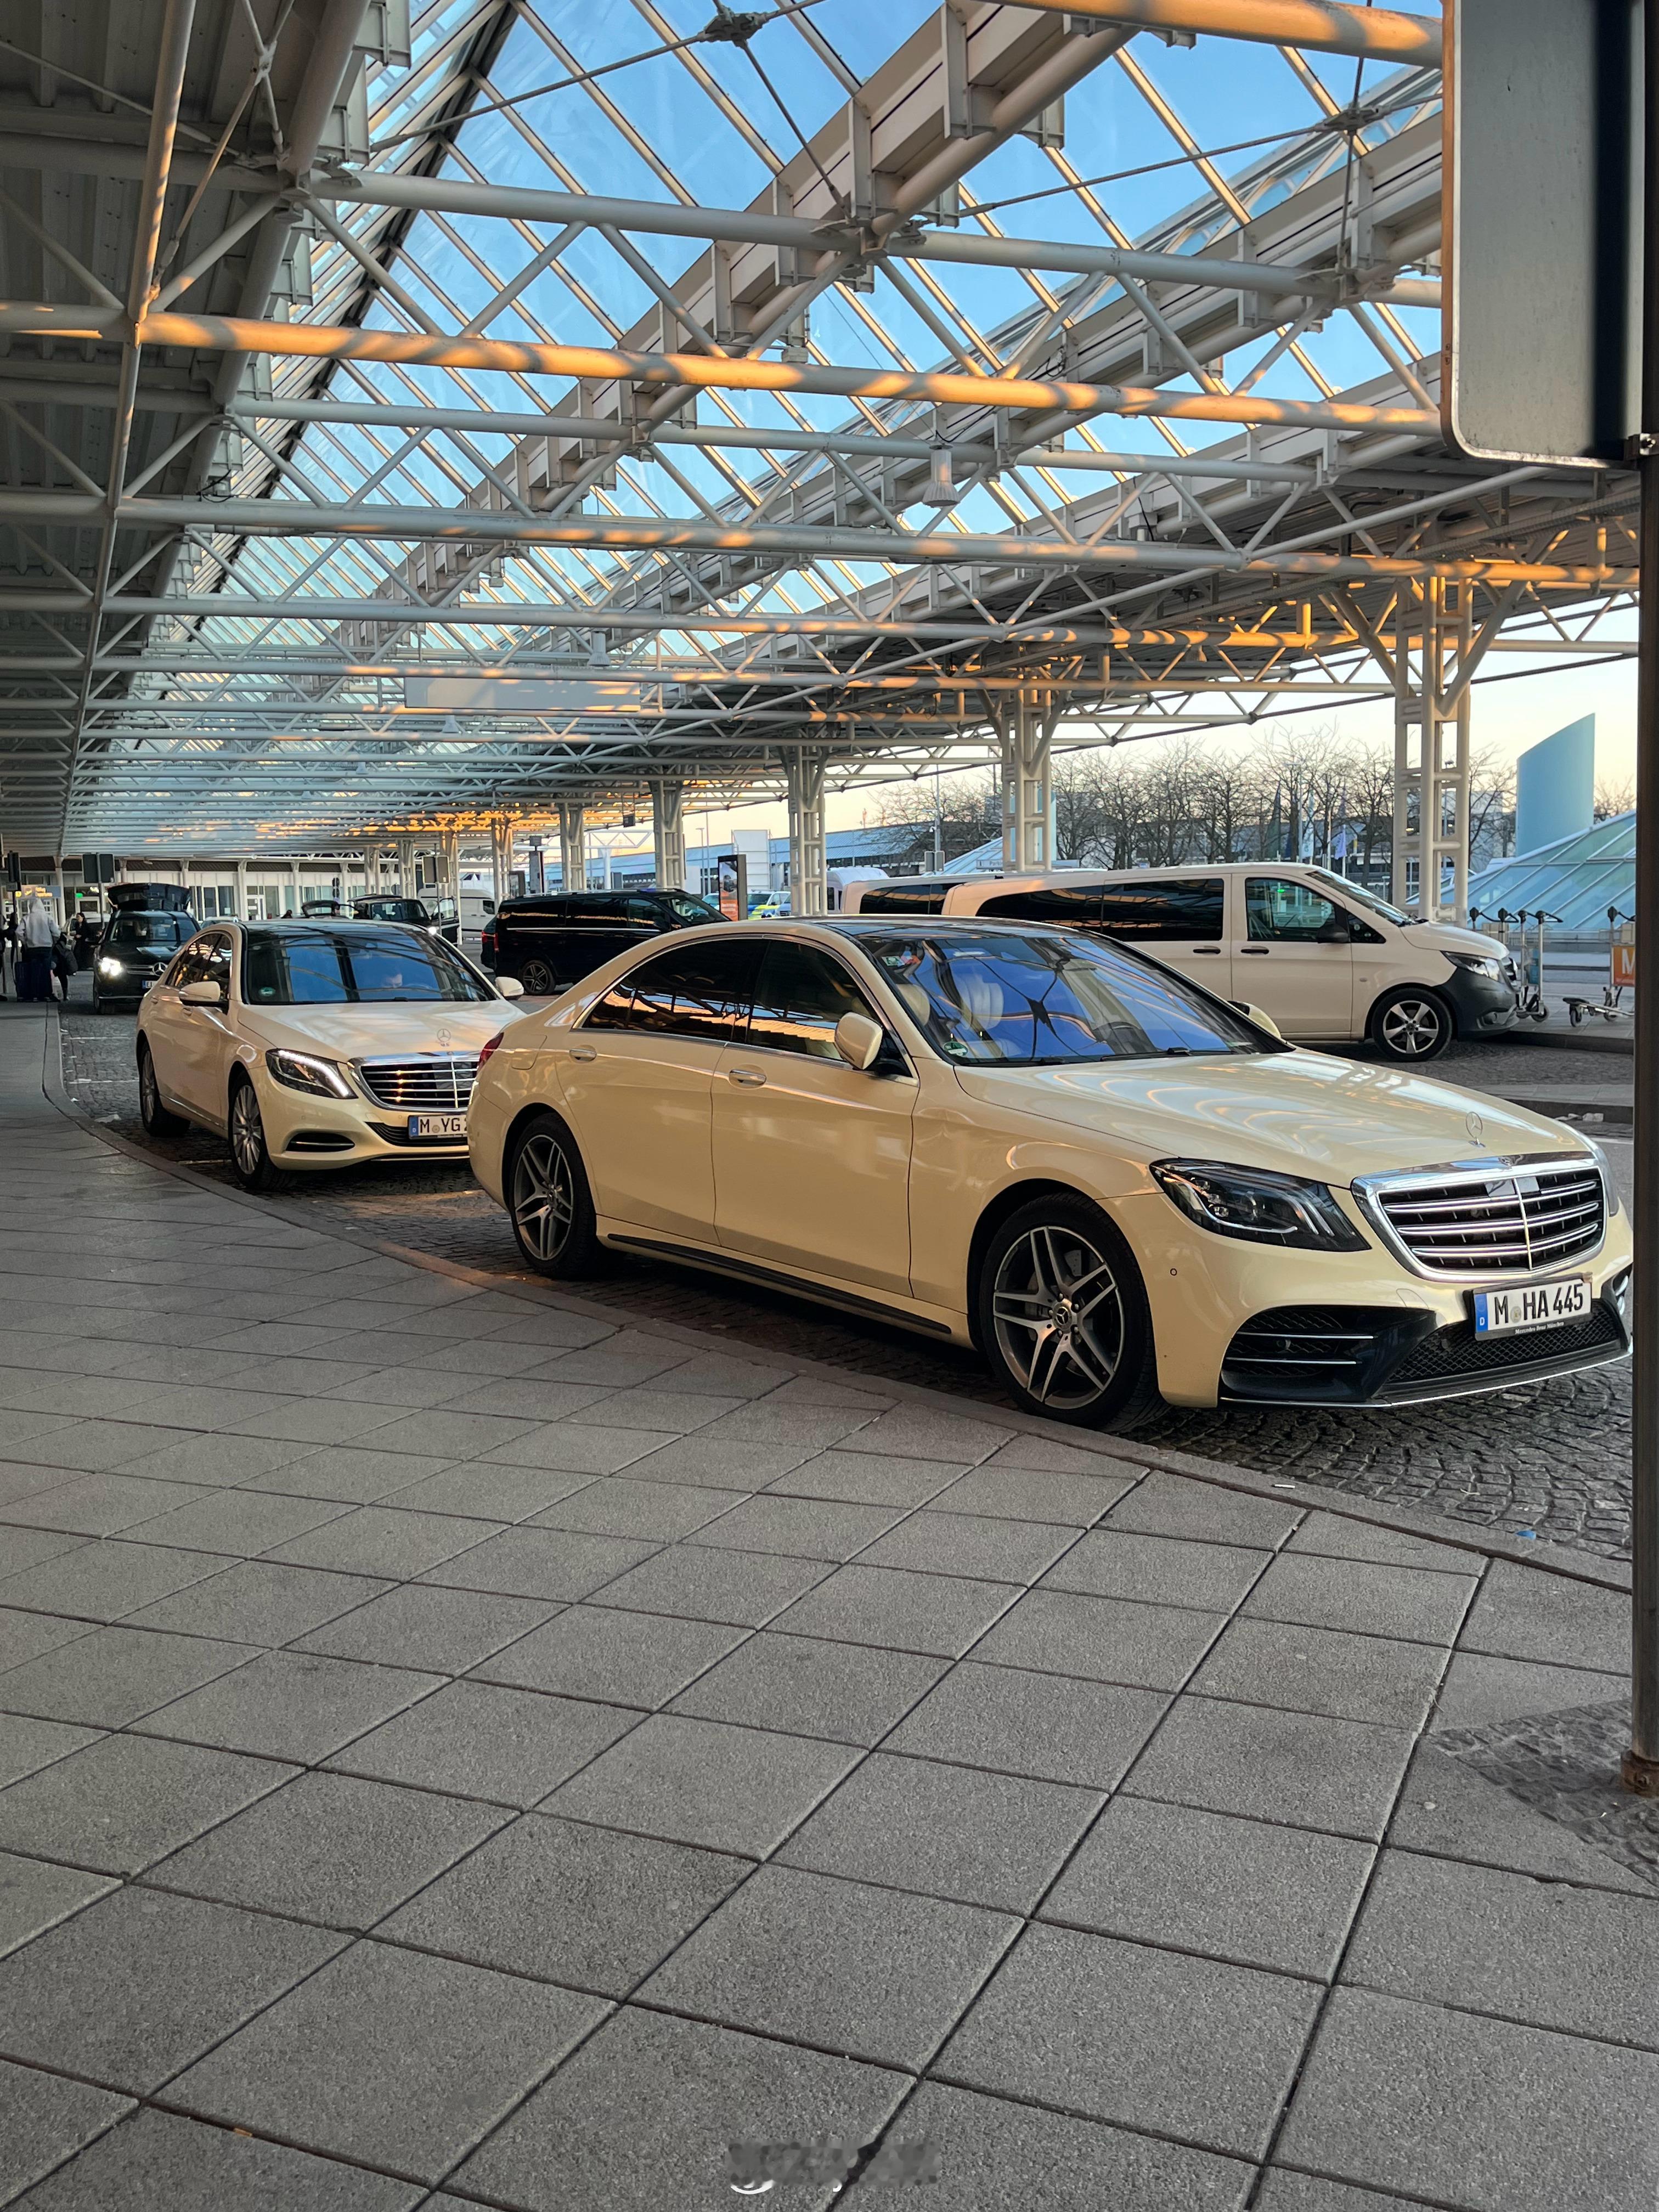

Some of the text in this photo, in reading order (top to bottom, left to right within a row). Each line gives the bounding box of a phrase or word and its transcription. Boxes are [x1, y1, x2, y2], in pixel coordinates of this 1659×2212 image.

[420, 1119, 430, 1133] M
[441, 1118, 460, 1132] YG
[1494, 1283, 1583, 1325] M HA 445
[1479, 1317, 1485, 1326] D
